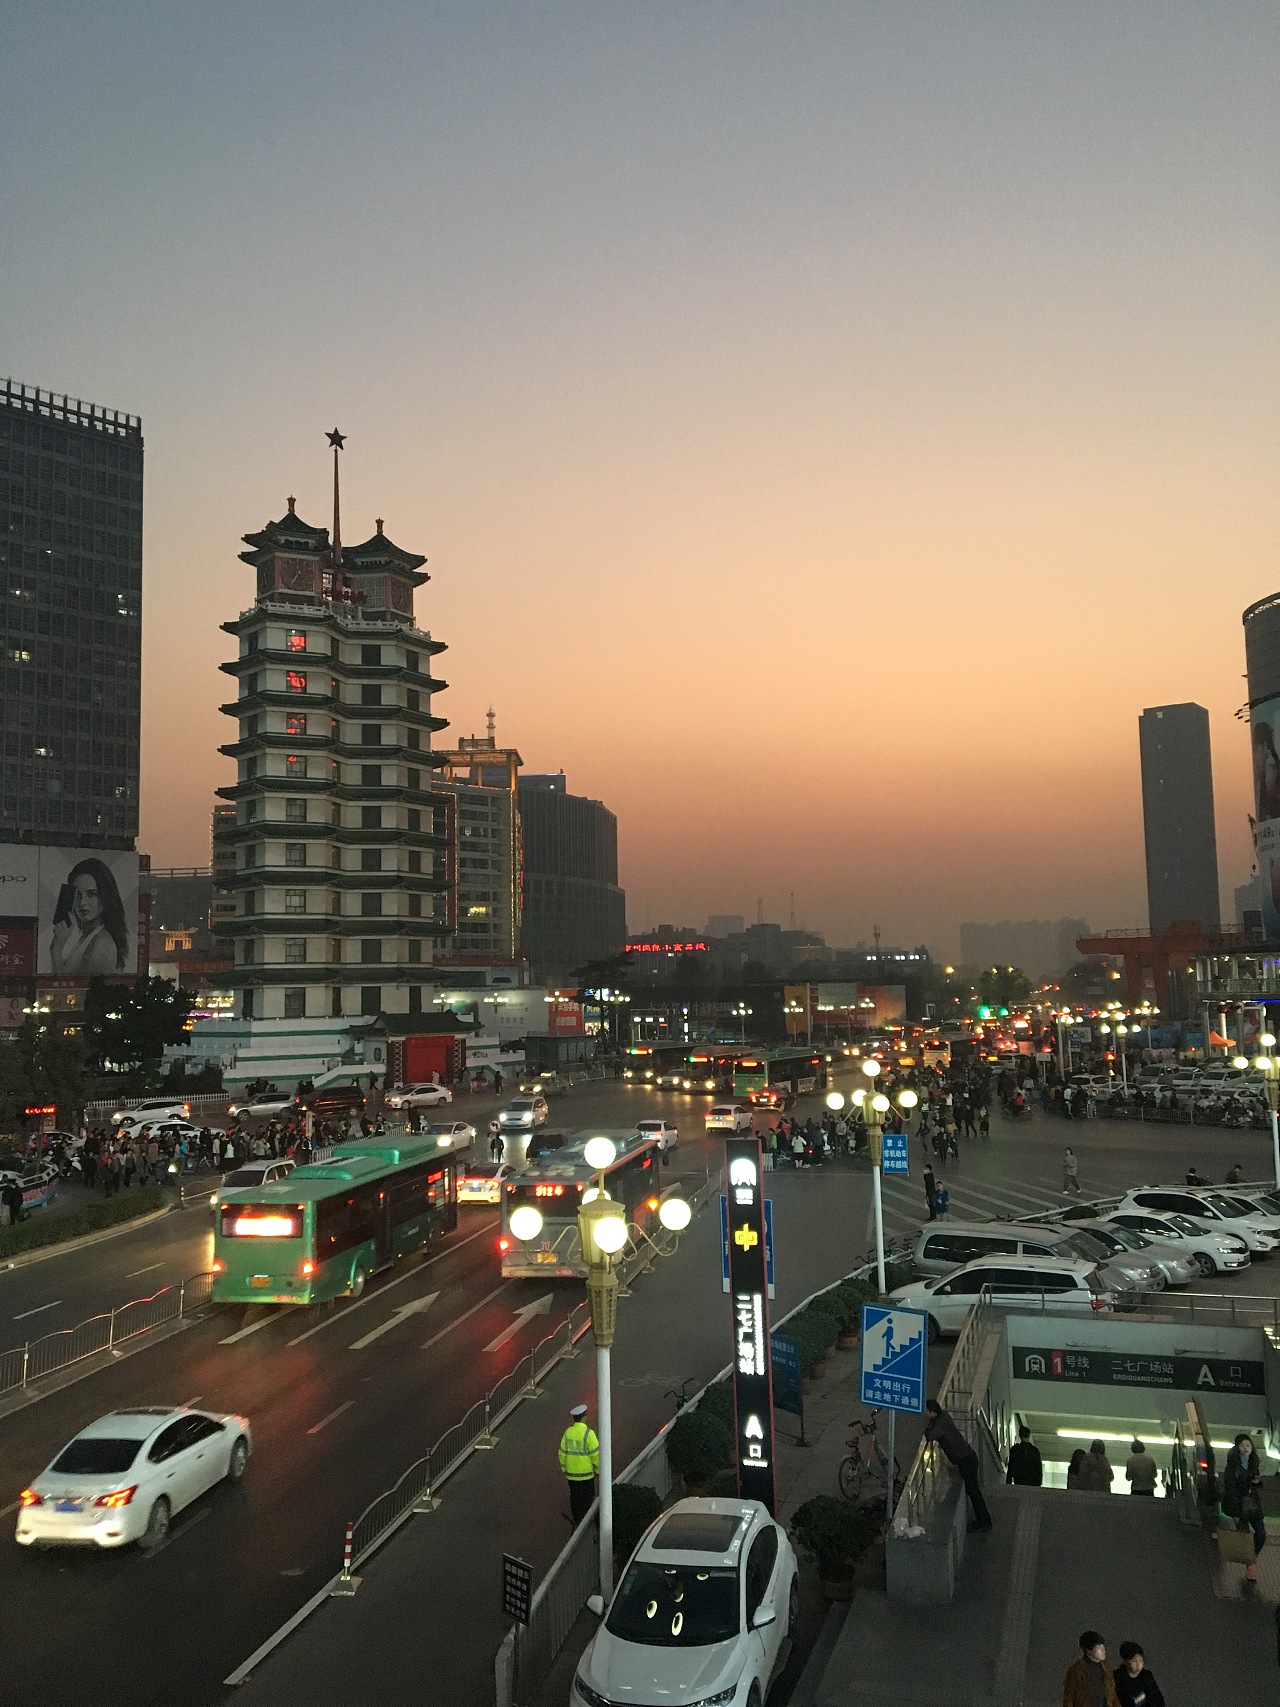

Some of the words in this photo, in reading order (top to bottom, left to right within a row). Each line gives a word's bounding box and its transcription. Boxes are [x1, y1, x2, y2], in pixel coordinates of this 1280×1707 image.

[1110, 1359, 1175, 1375] 二七广场站
[1197, 1364, 1216, 1387] A
[1220, 1379, 1252, 1388] Entrance
[873, 1378, 911, 1394] 文明出行
